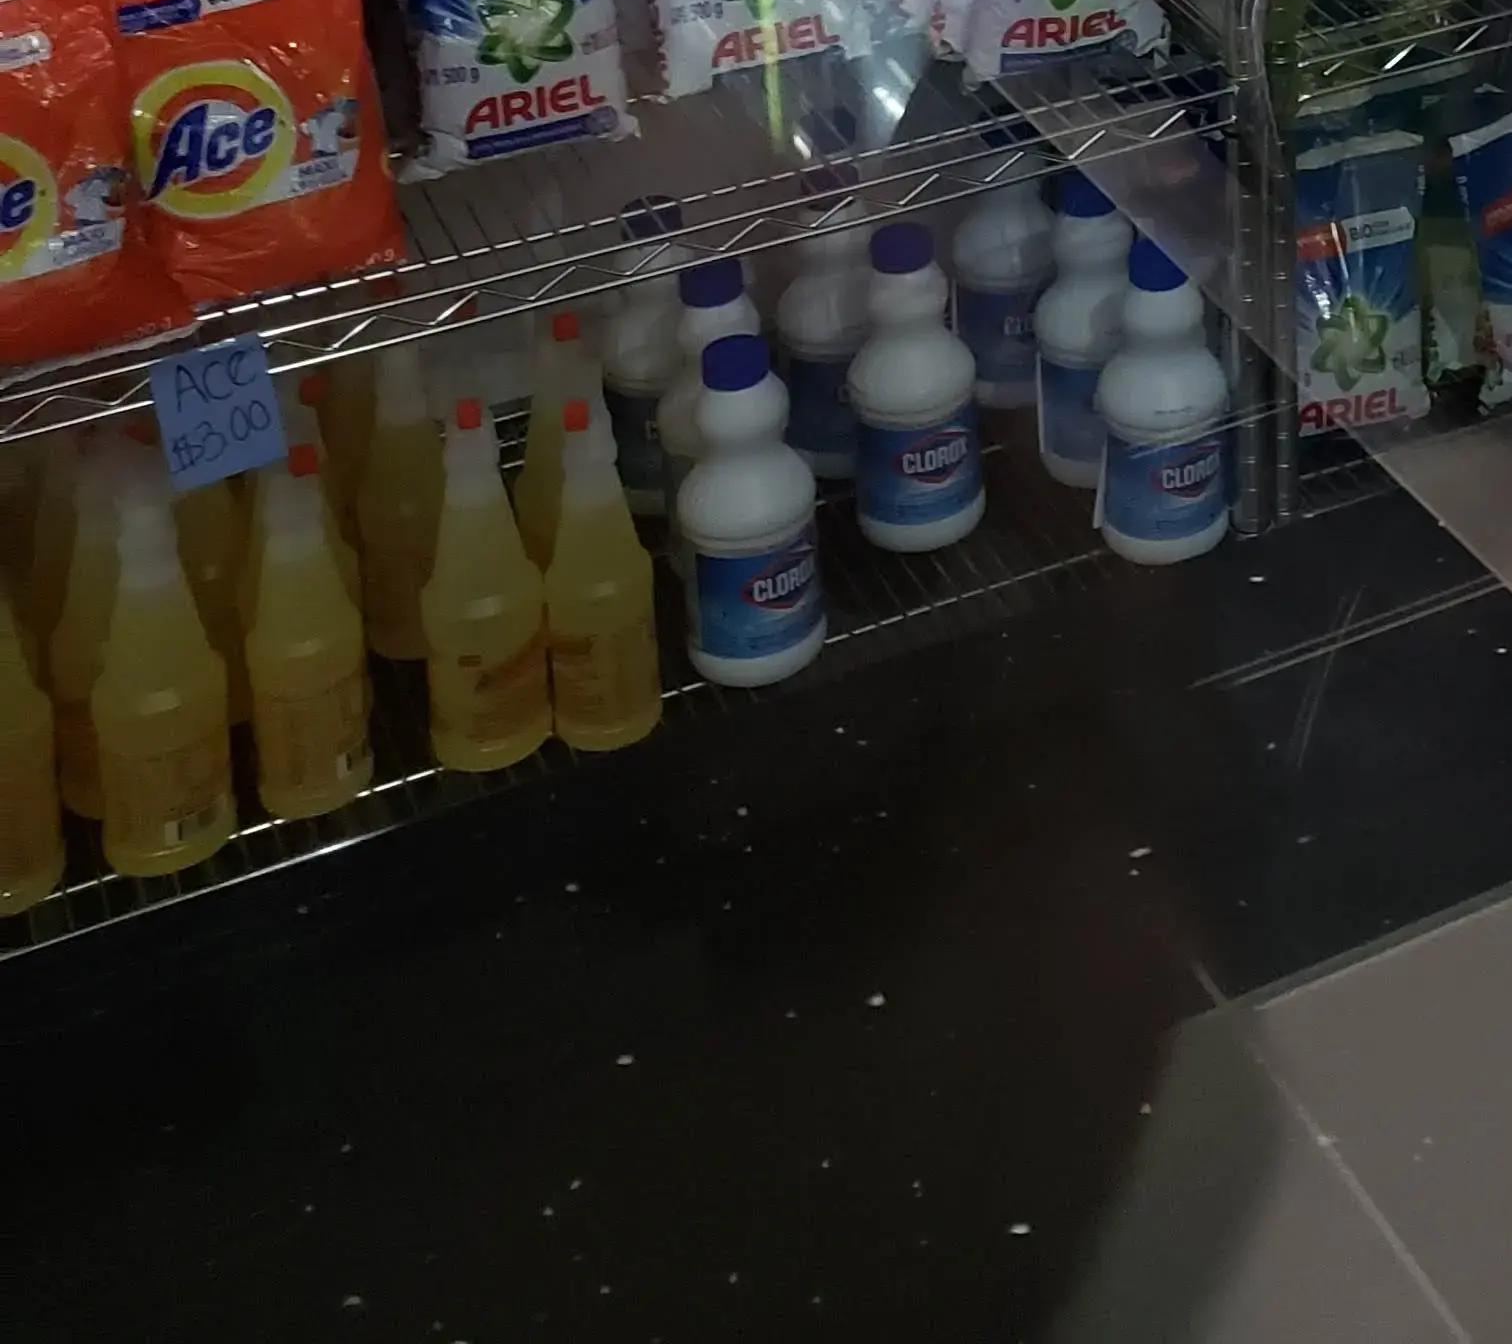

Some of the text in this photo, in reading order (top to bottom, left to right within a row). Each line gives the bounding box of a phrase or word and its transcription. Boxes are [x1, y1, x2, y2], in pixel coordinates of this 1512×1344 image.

[711, 13, 841, 69] ARIEL
[1001, 8, 1127, 49] ARIEL
[463, 74, 606, 135] ARIEL
[148, 102, 277, 200] Ace
[1298, 386, 1408, 430] ARIEL
[901, 434, 968, 477] CLOROX
